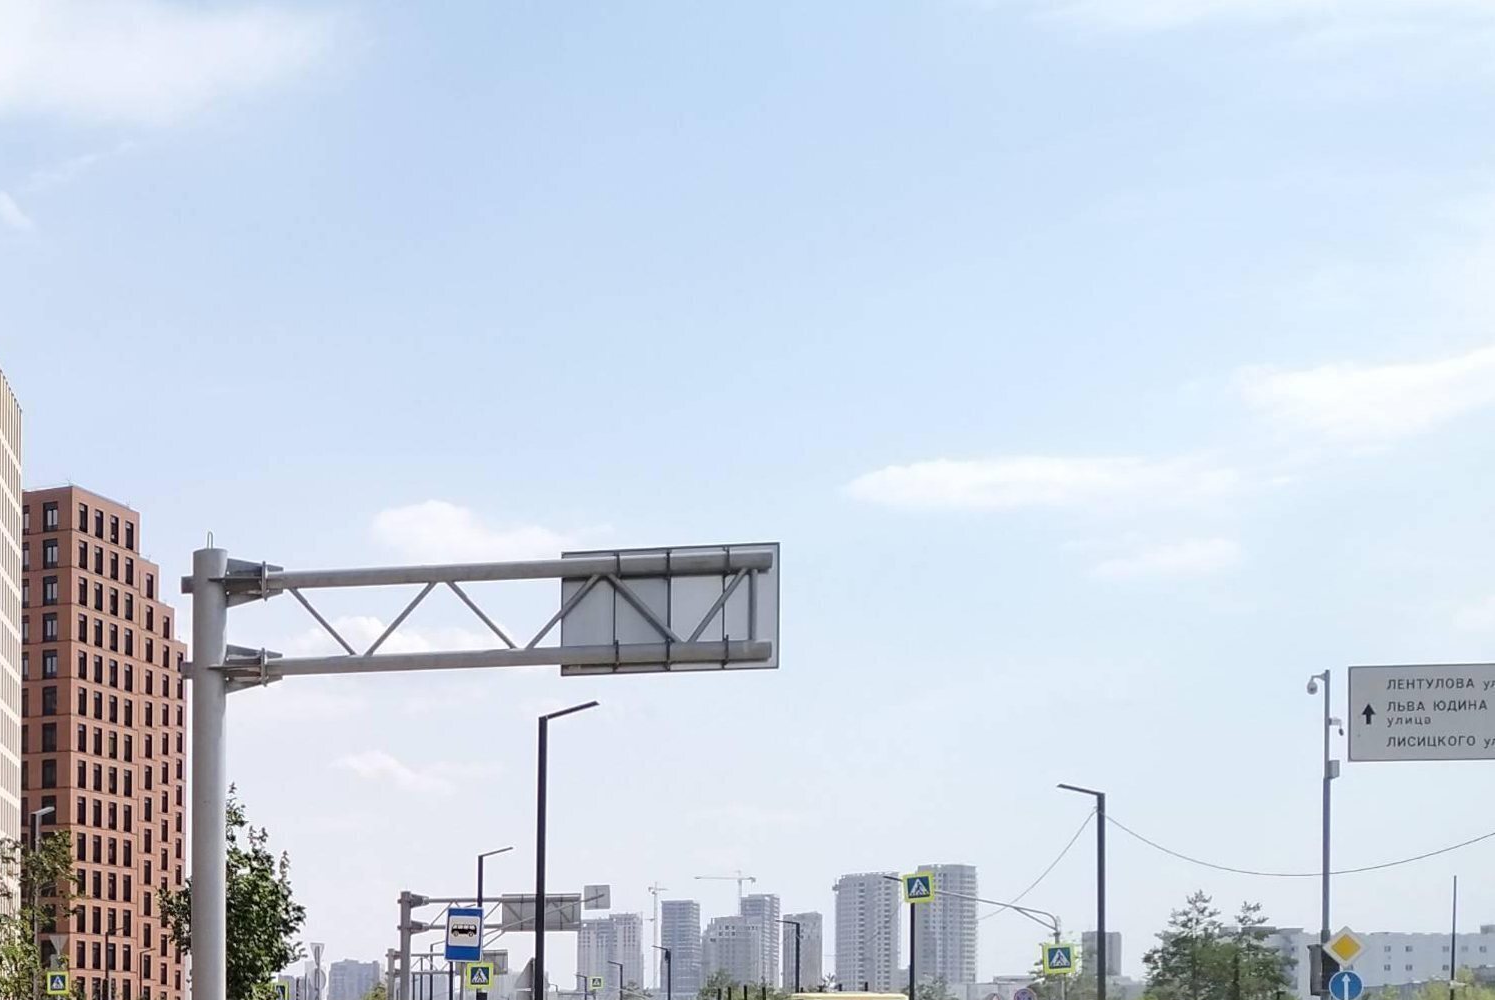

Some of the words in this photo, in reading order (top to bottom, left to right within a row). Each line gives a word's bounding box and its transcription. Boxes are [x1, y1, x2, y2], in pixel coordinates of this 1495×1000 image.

[1386, 678, 1475, 690] ЛЕНТУЛОВА
[1386, 700, 1426, 712] ЛЬВА
[1433, 700, 1488, 712] ЮДИНА
[1387, 716, 1432, 728] улица
[1386, 735, 1476, 748] ЛИСИЦКОГО
